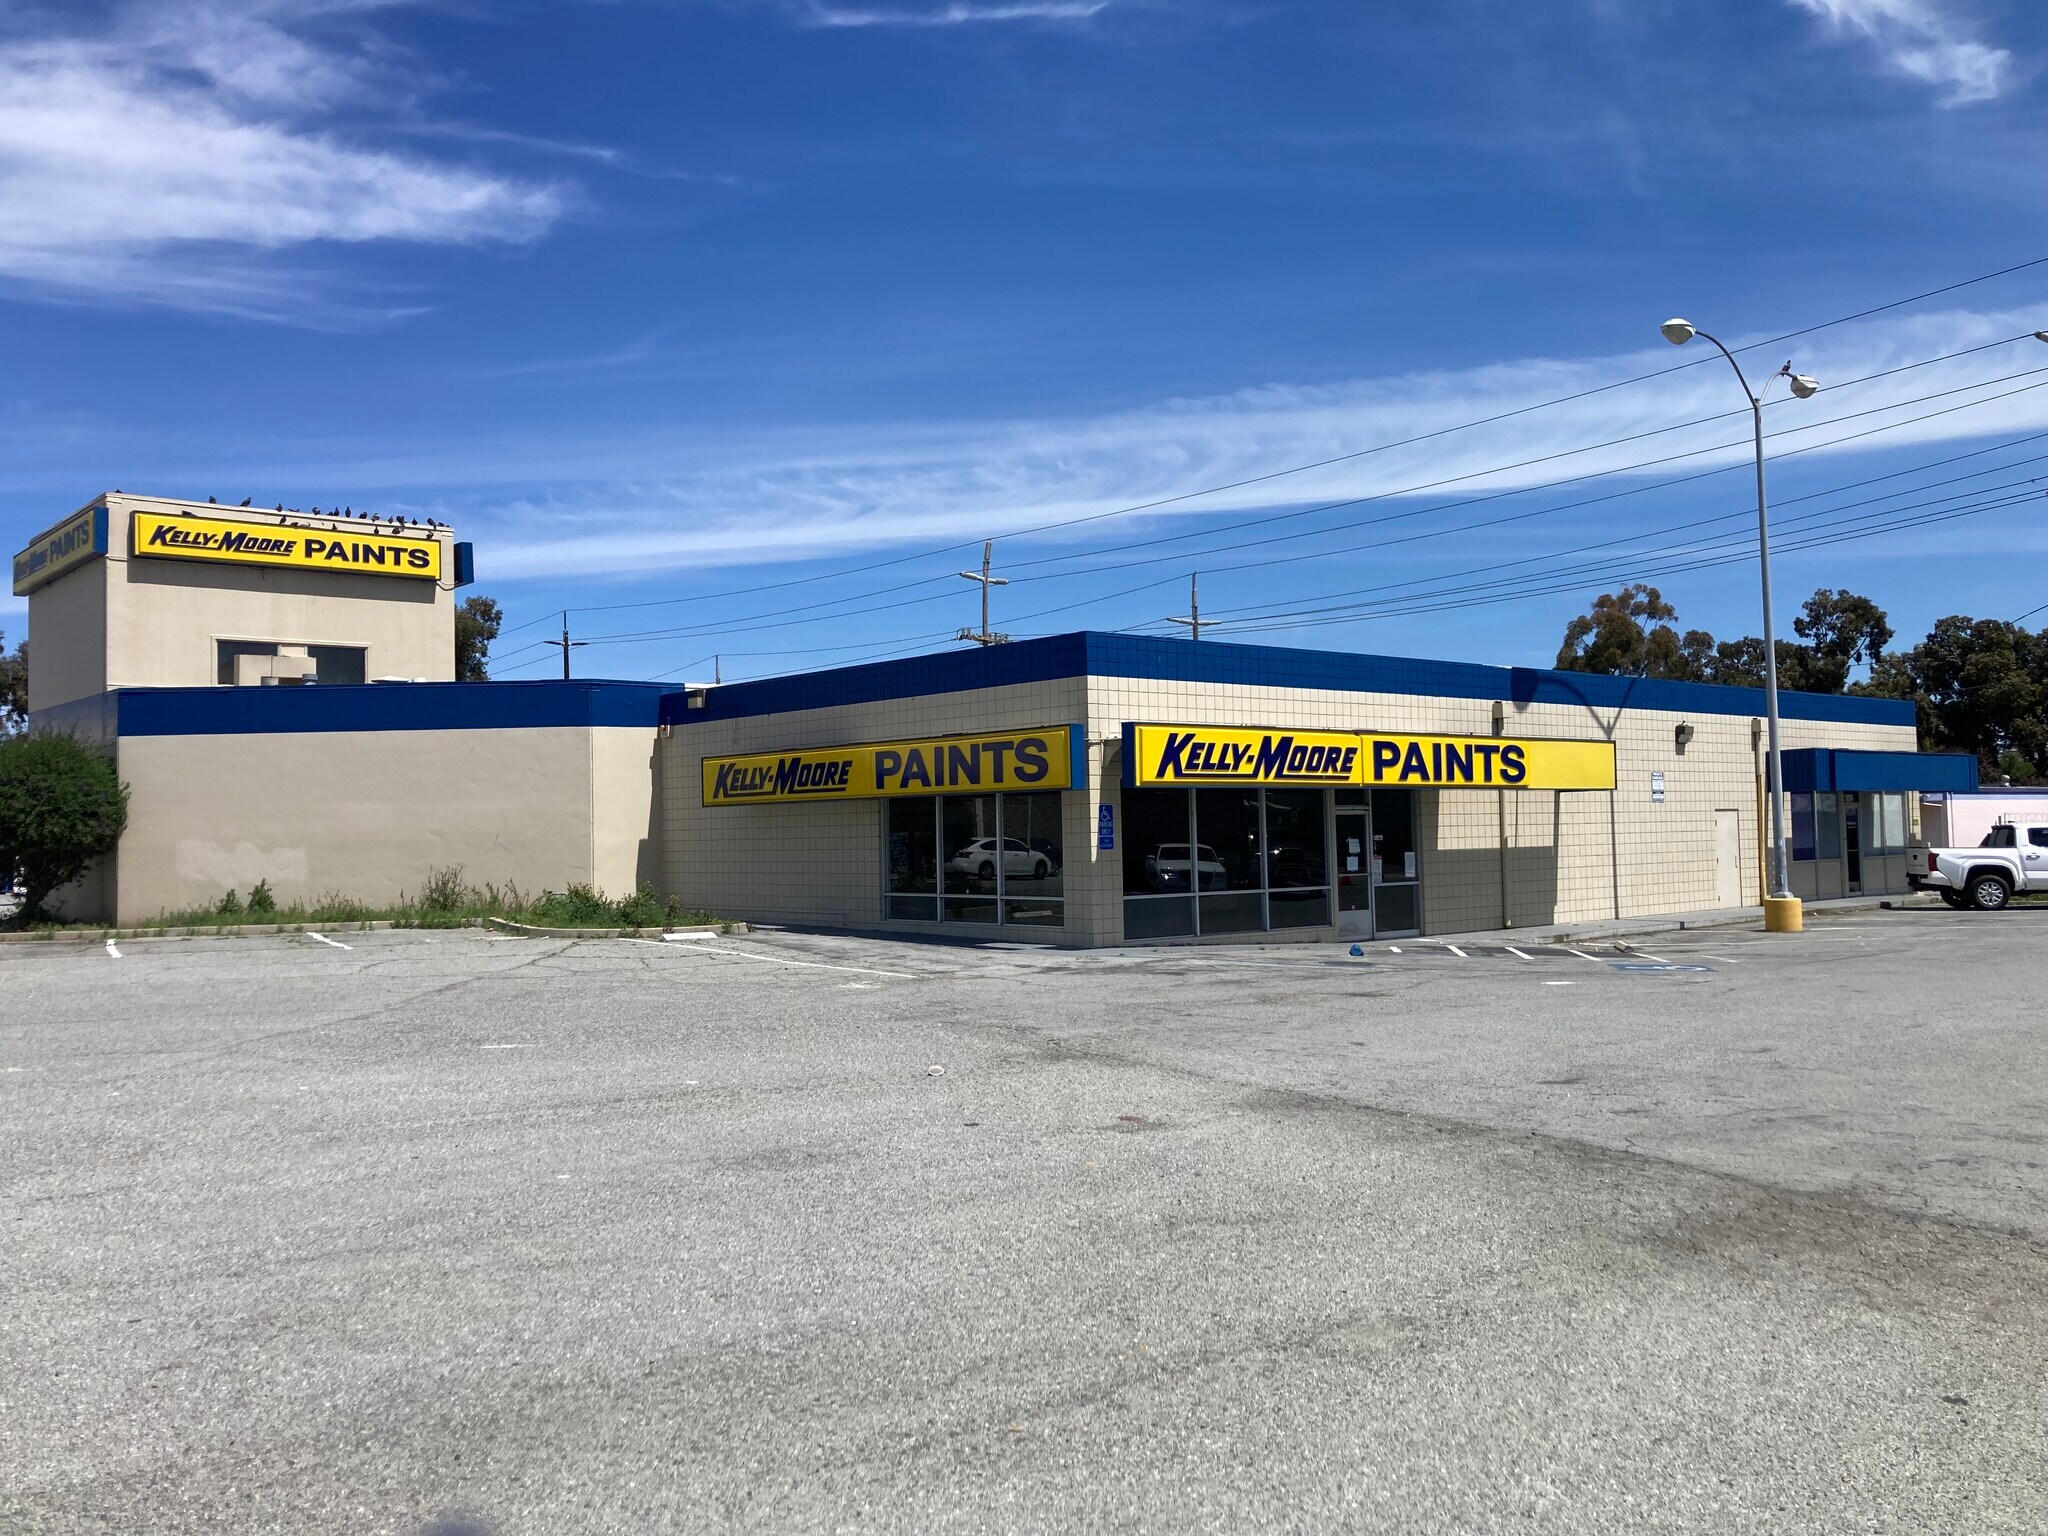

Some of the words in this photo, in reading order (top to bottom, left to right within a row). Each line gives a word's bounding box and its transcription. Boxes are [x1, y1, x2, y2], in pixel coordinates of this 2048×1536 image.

[49, 519, 90, 564] PAINTS
[147, 524, 297, 557] KELLY-MOORE
[304, 538, 430, 569] PAINTS
[712, 757, 854, 799] KELLY-MOORE
[874, 738, 1049, 789] PAINTS
[1155, 733, 1359, 781] KELLY-MOORE
[1372, 740, 1526, 784] PAINTS
